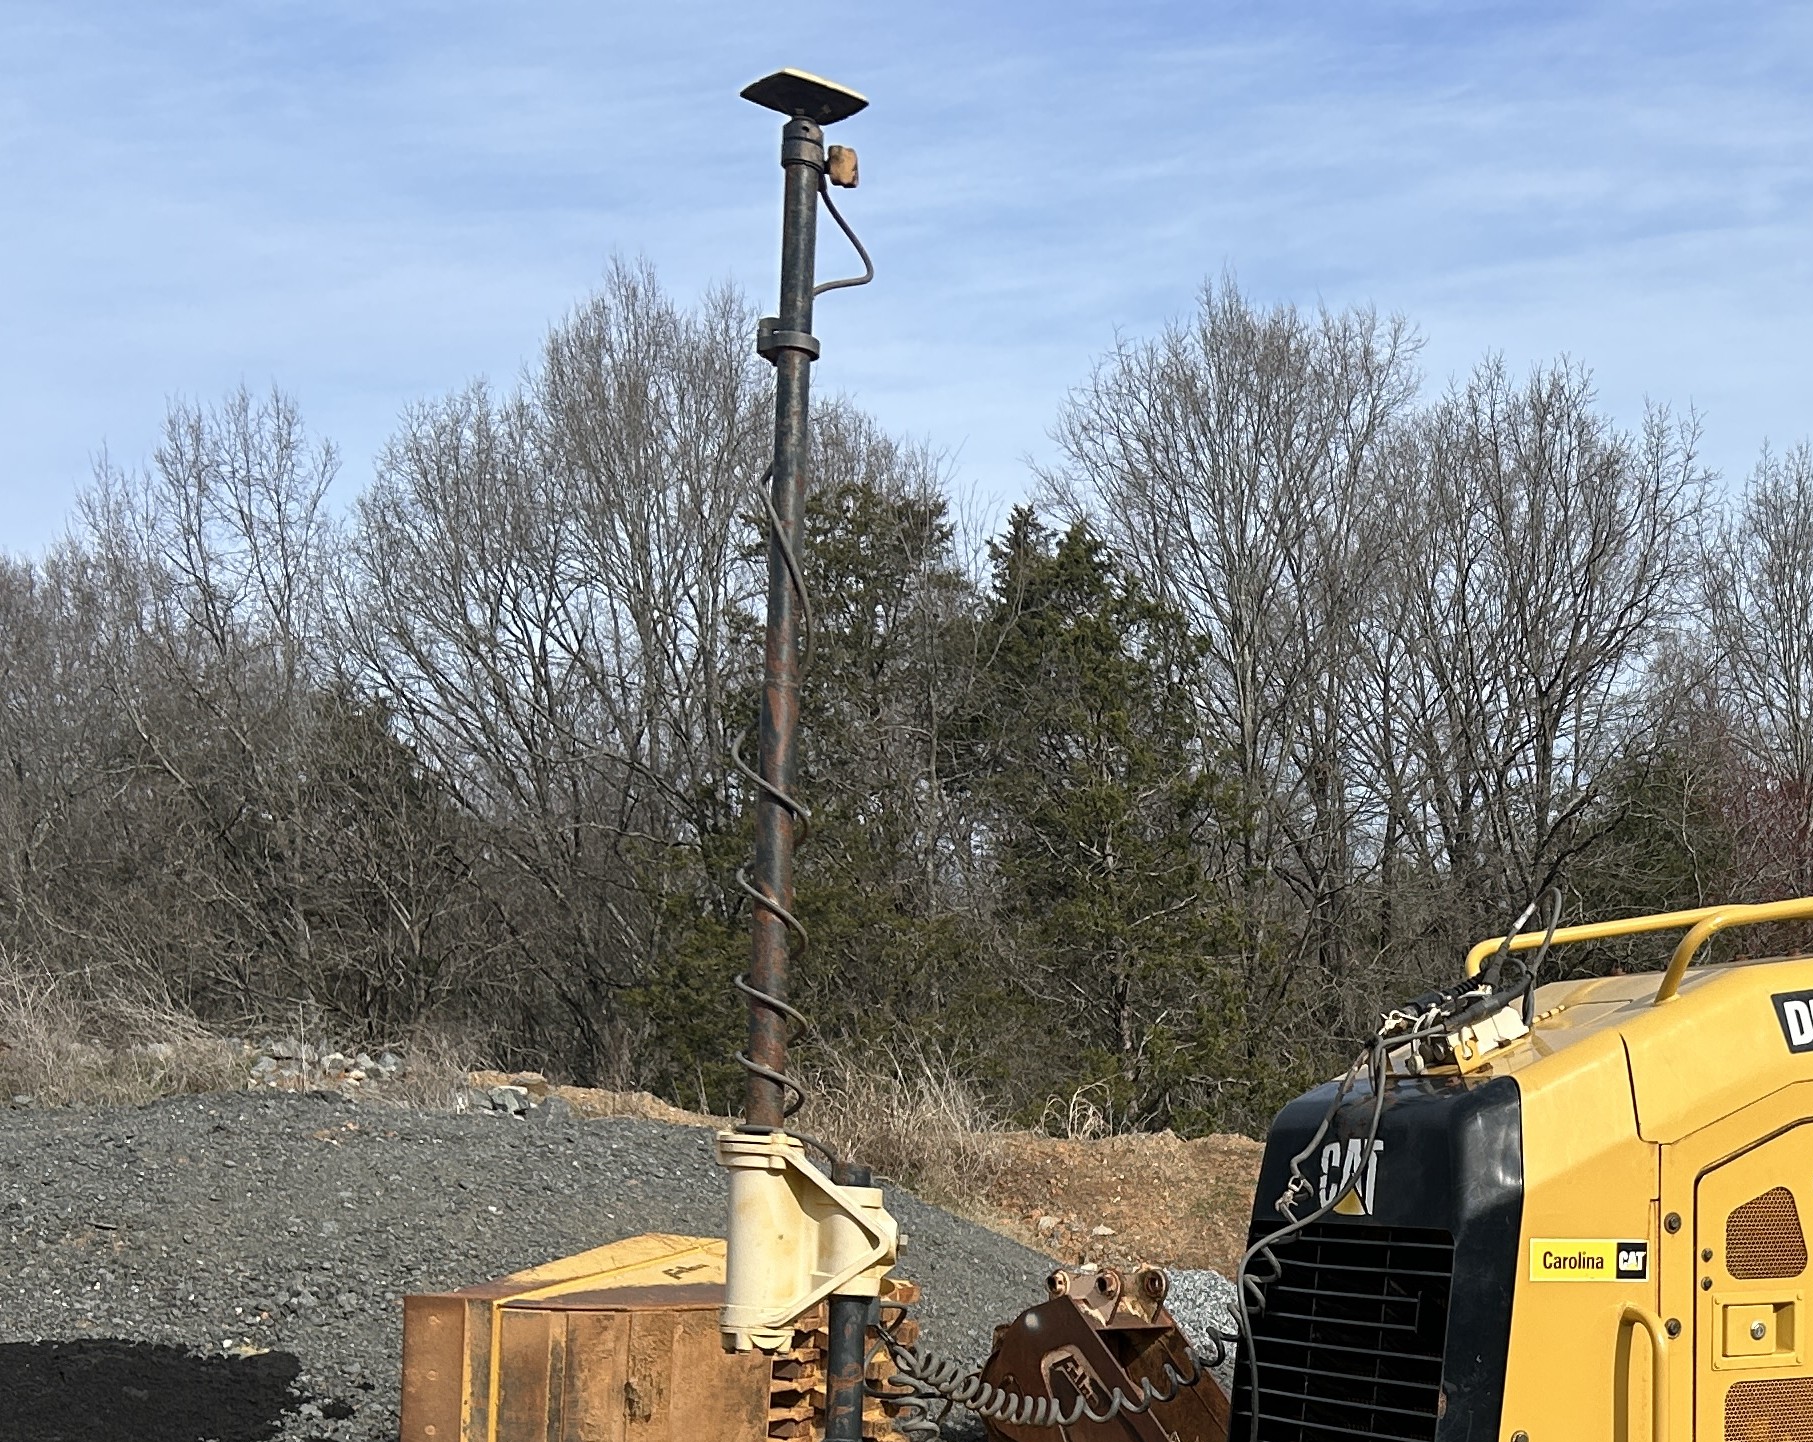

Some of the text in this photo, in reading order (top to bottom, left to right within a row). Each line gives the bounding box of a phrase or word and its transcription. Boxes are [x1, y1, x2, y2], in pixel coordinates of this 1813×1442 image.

[1319, 1138, 1385, 1216] CAT
[1543, 1250, 1647, 1271] Carolina CAT
